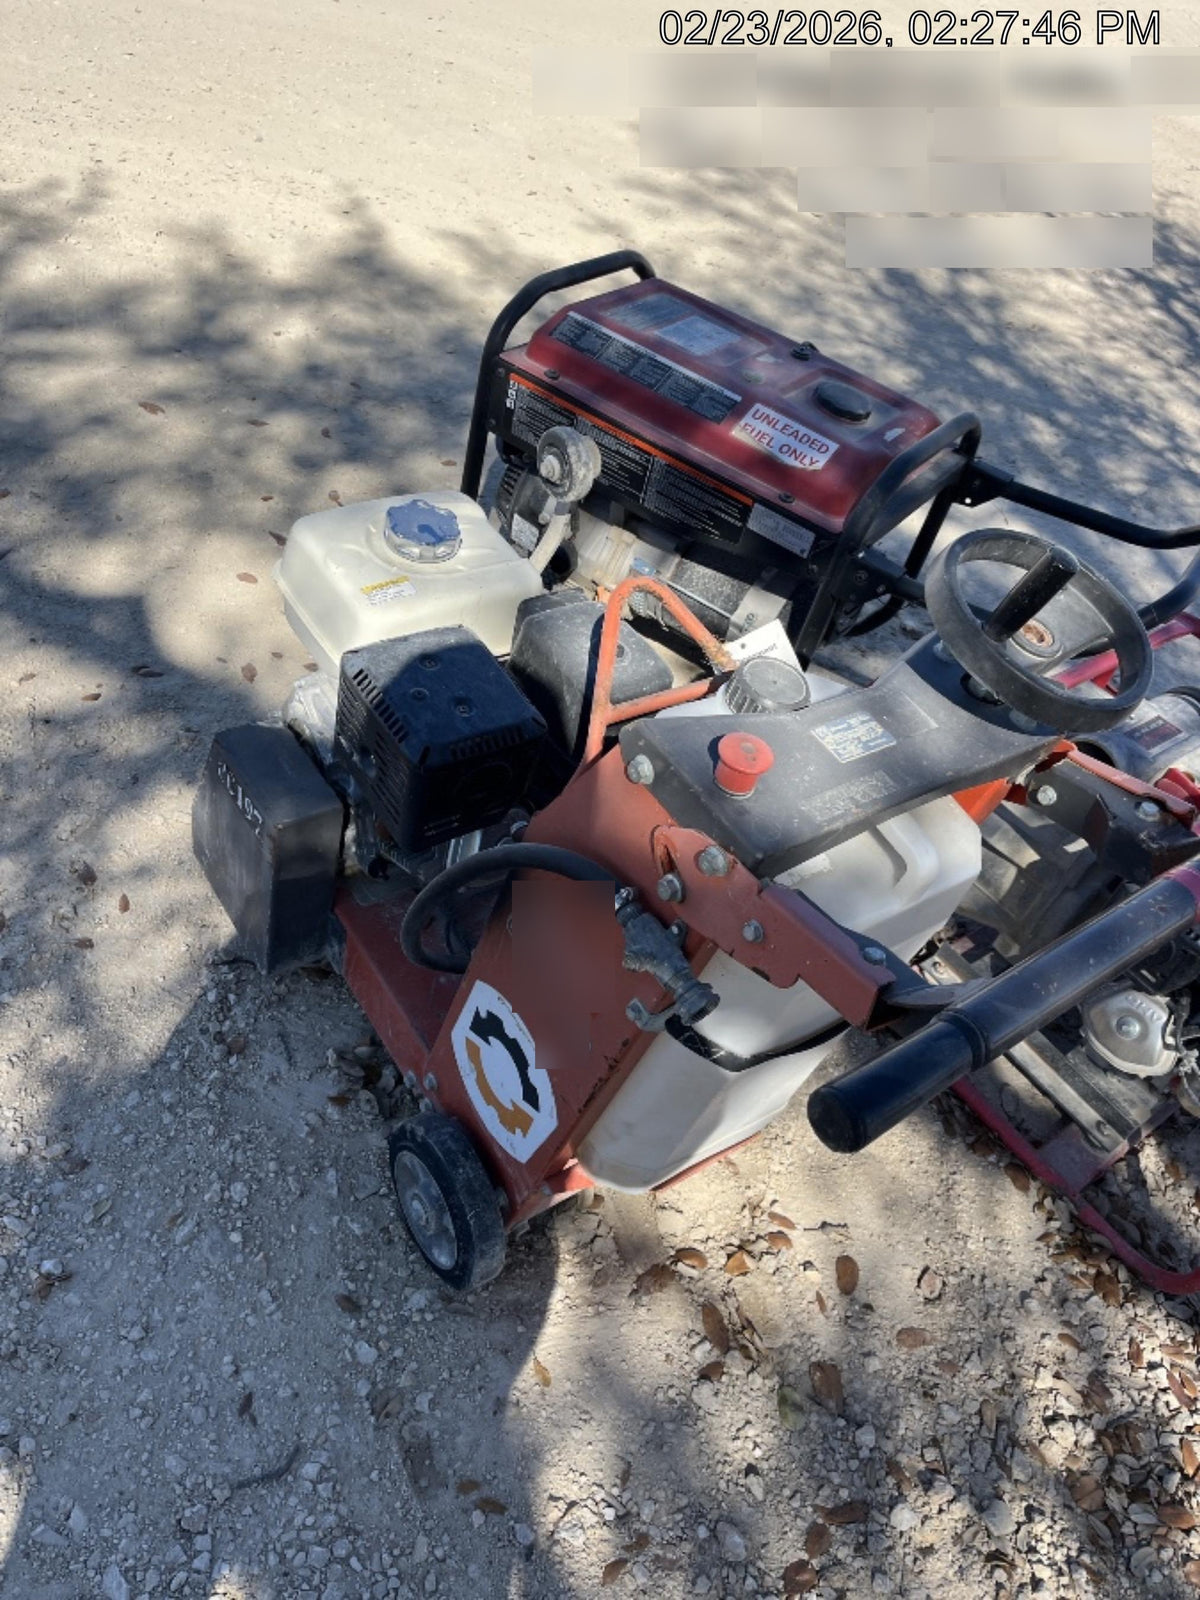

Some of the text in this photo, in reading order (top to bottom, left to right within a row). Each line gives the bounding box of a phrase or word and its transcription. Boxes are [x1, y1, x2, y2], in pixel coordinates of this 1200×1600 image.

[742, 422, 820, 467] FUEL ONLY
[751, 408, 830, 455] UNLEADED
